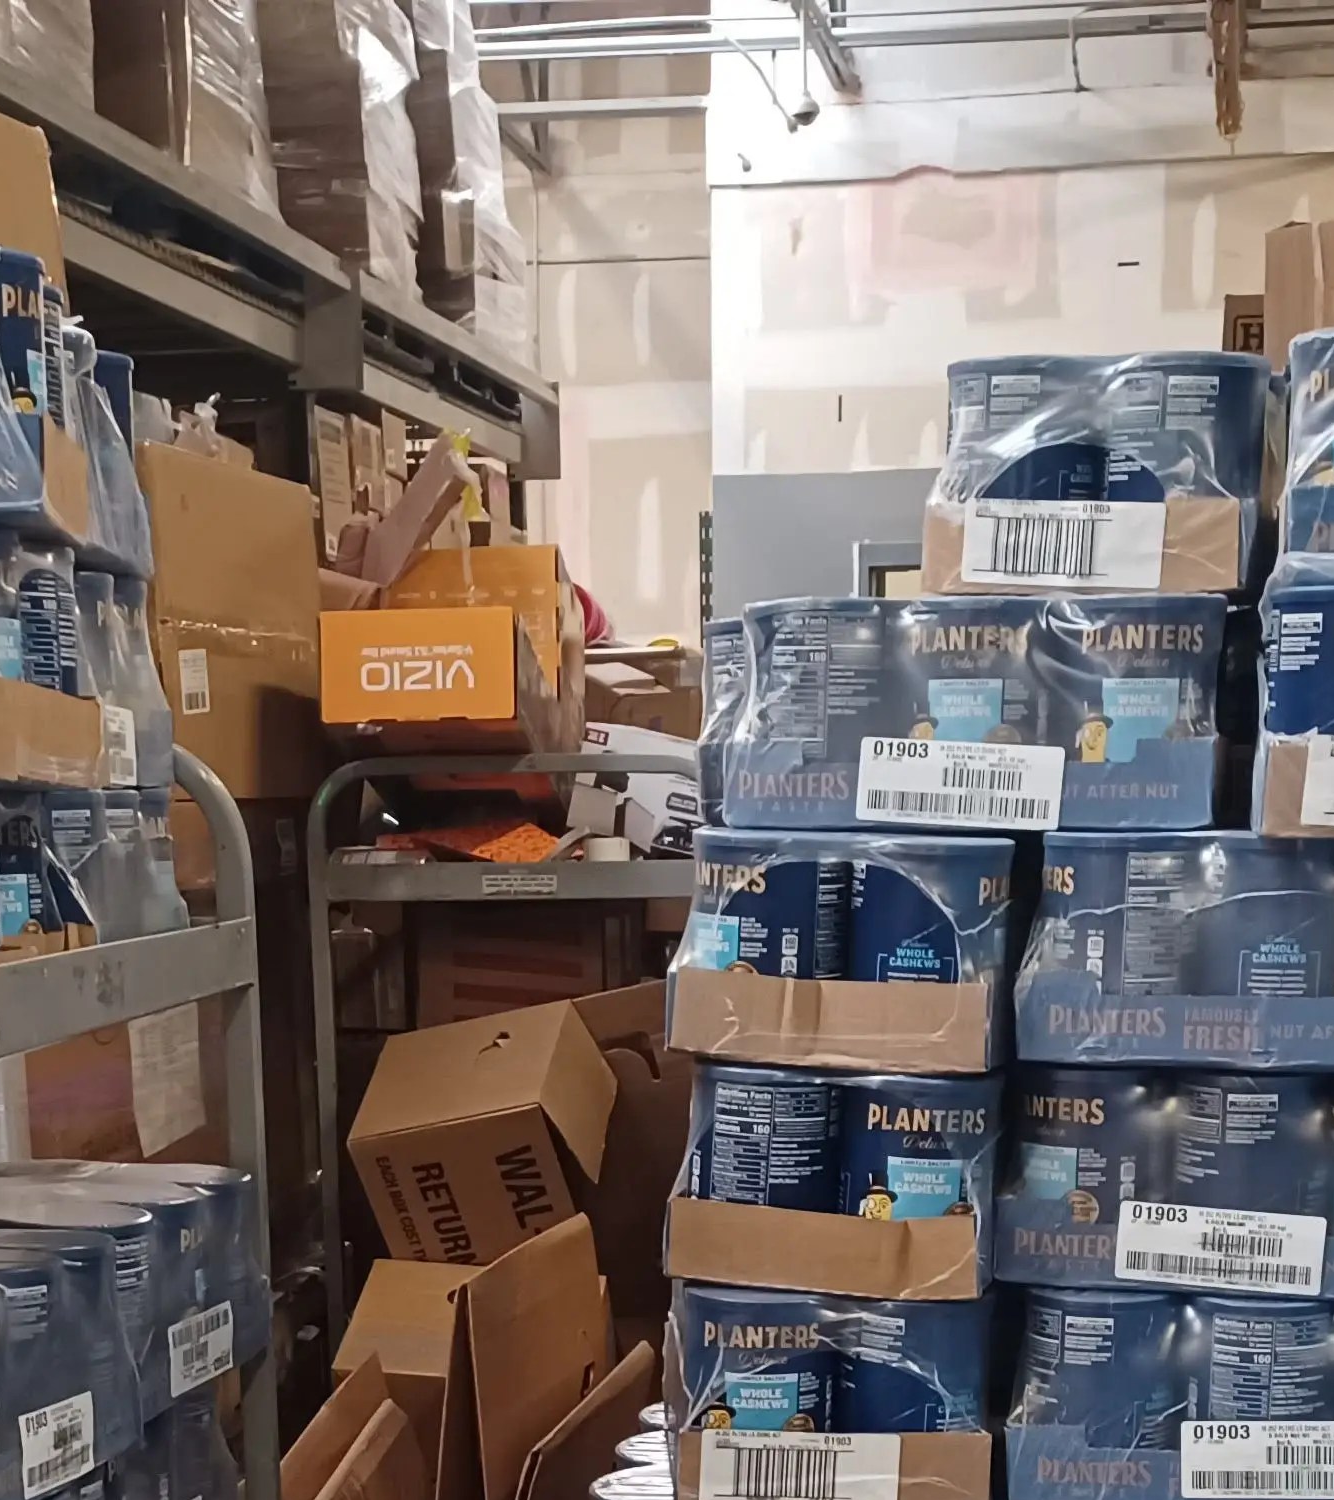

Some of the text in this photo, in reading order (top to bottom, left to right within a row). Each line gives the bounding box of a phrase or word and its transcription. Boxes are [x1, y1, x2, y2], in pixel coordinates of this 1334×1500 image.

[911, 624, 1028, 655] PLANTERS
[1081, 623, 1204, 654] PLANTERS
[361, 659, 474, 691] VIZIO
[873, 741, 928, 758] 01903
[738, 773, 849, 800] PLANTERS
[888, 958, 941, 969] CASHEWS
[896, 948, 936, 961] WHOLE
[1048, 1007, 1167, 1039] PLANTERS
[752, 1123, 770, 1134] 160
[868, 1103, 986, 1136] PLANTERS
[895, 1182, 953, 1196] CASHEWS
[903, 1172, 948, 1186] WHOLE
[375, 1156, 399, 1191] EACH
[395, 1216, 420, 1249] COST
[1131, 1203, 1188, 1225] 01903
[704, 1321, 820, 1350] PLANTERS
[731, 1397, 799, 1412] CASHEWS
[739, 1387, 783, 1401] WHOLE
[24, 1413, 49, 1436] 01903
[1193, 1424, 1250, 1439] 01903
[823, 1436, 852, 1447] 01903
[1036, 1457, 1152, 1489] PLANTERS
